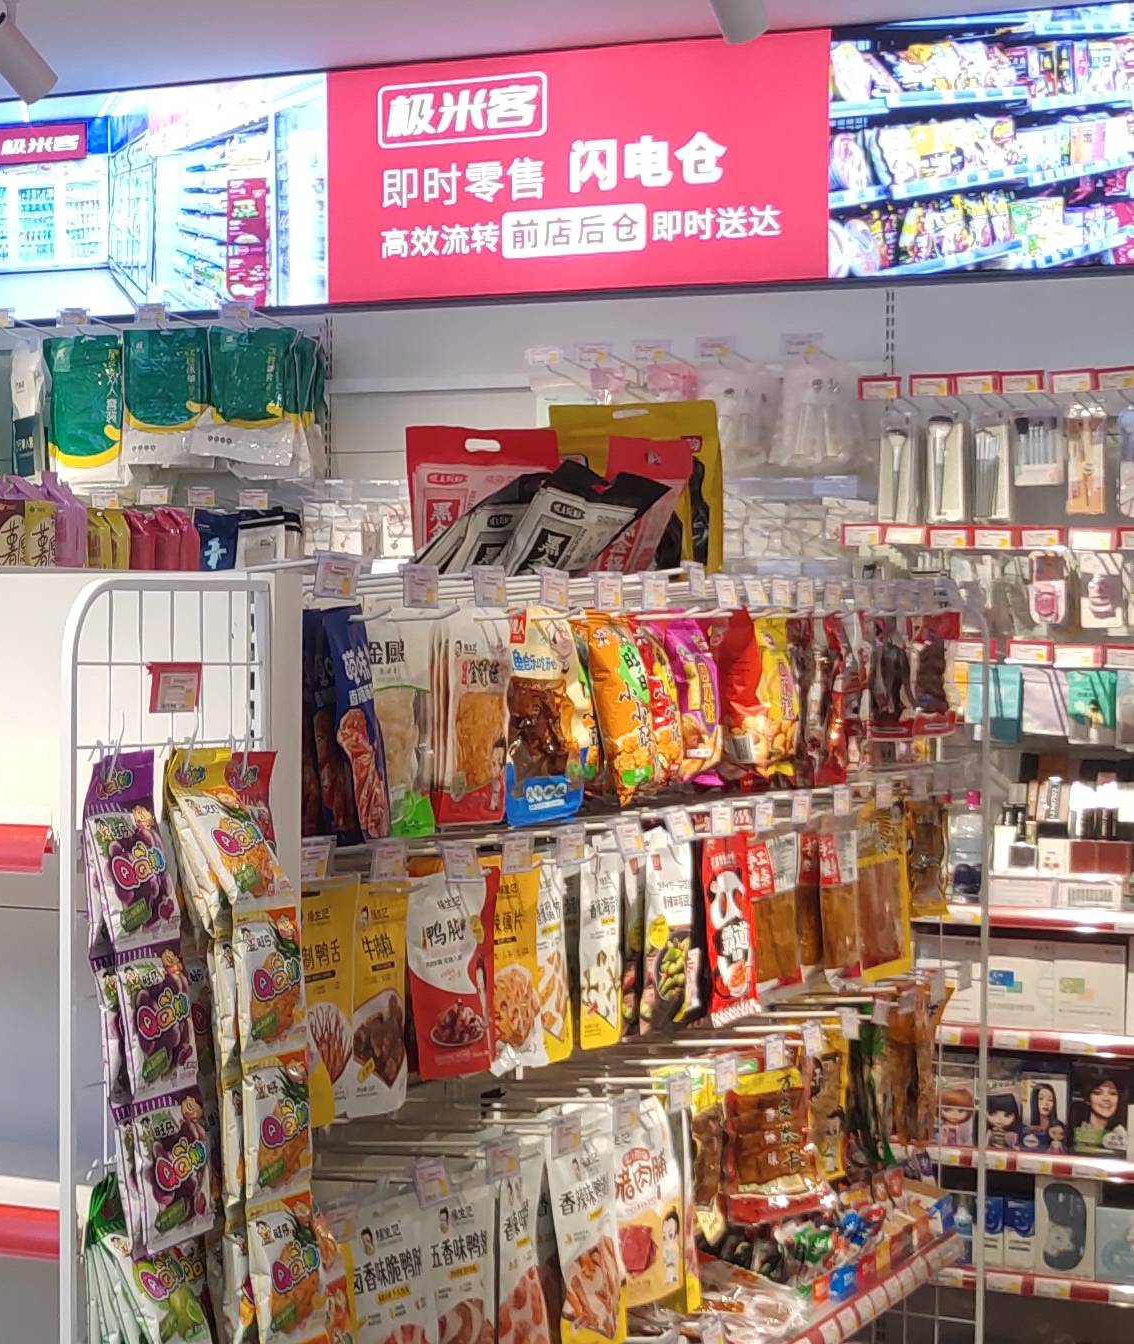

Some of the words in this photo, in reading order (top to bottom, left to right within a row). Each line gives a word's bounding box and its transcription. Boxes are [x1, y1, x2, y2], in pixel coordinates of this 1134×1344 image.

[386, 84, 540, 138] 极米客
[0, 134, 80, 156] 极米客
[381, 156, 545, 209] 即时零售
[568, 131, 727, 194] 闪电仓
[380, 221, 500, 260] 高效流转
[511, 212, 639, 251] 前店后仓
[651, 203, 783, 242] 即时送达
